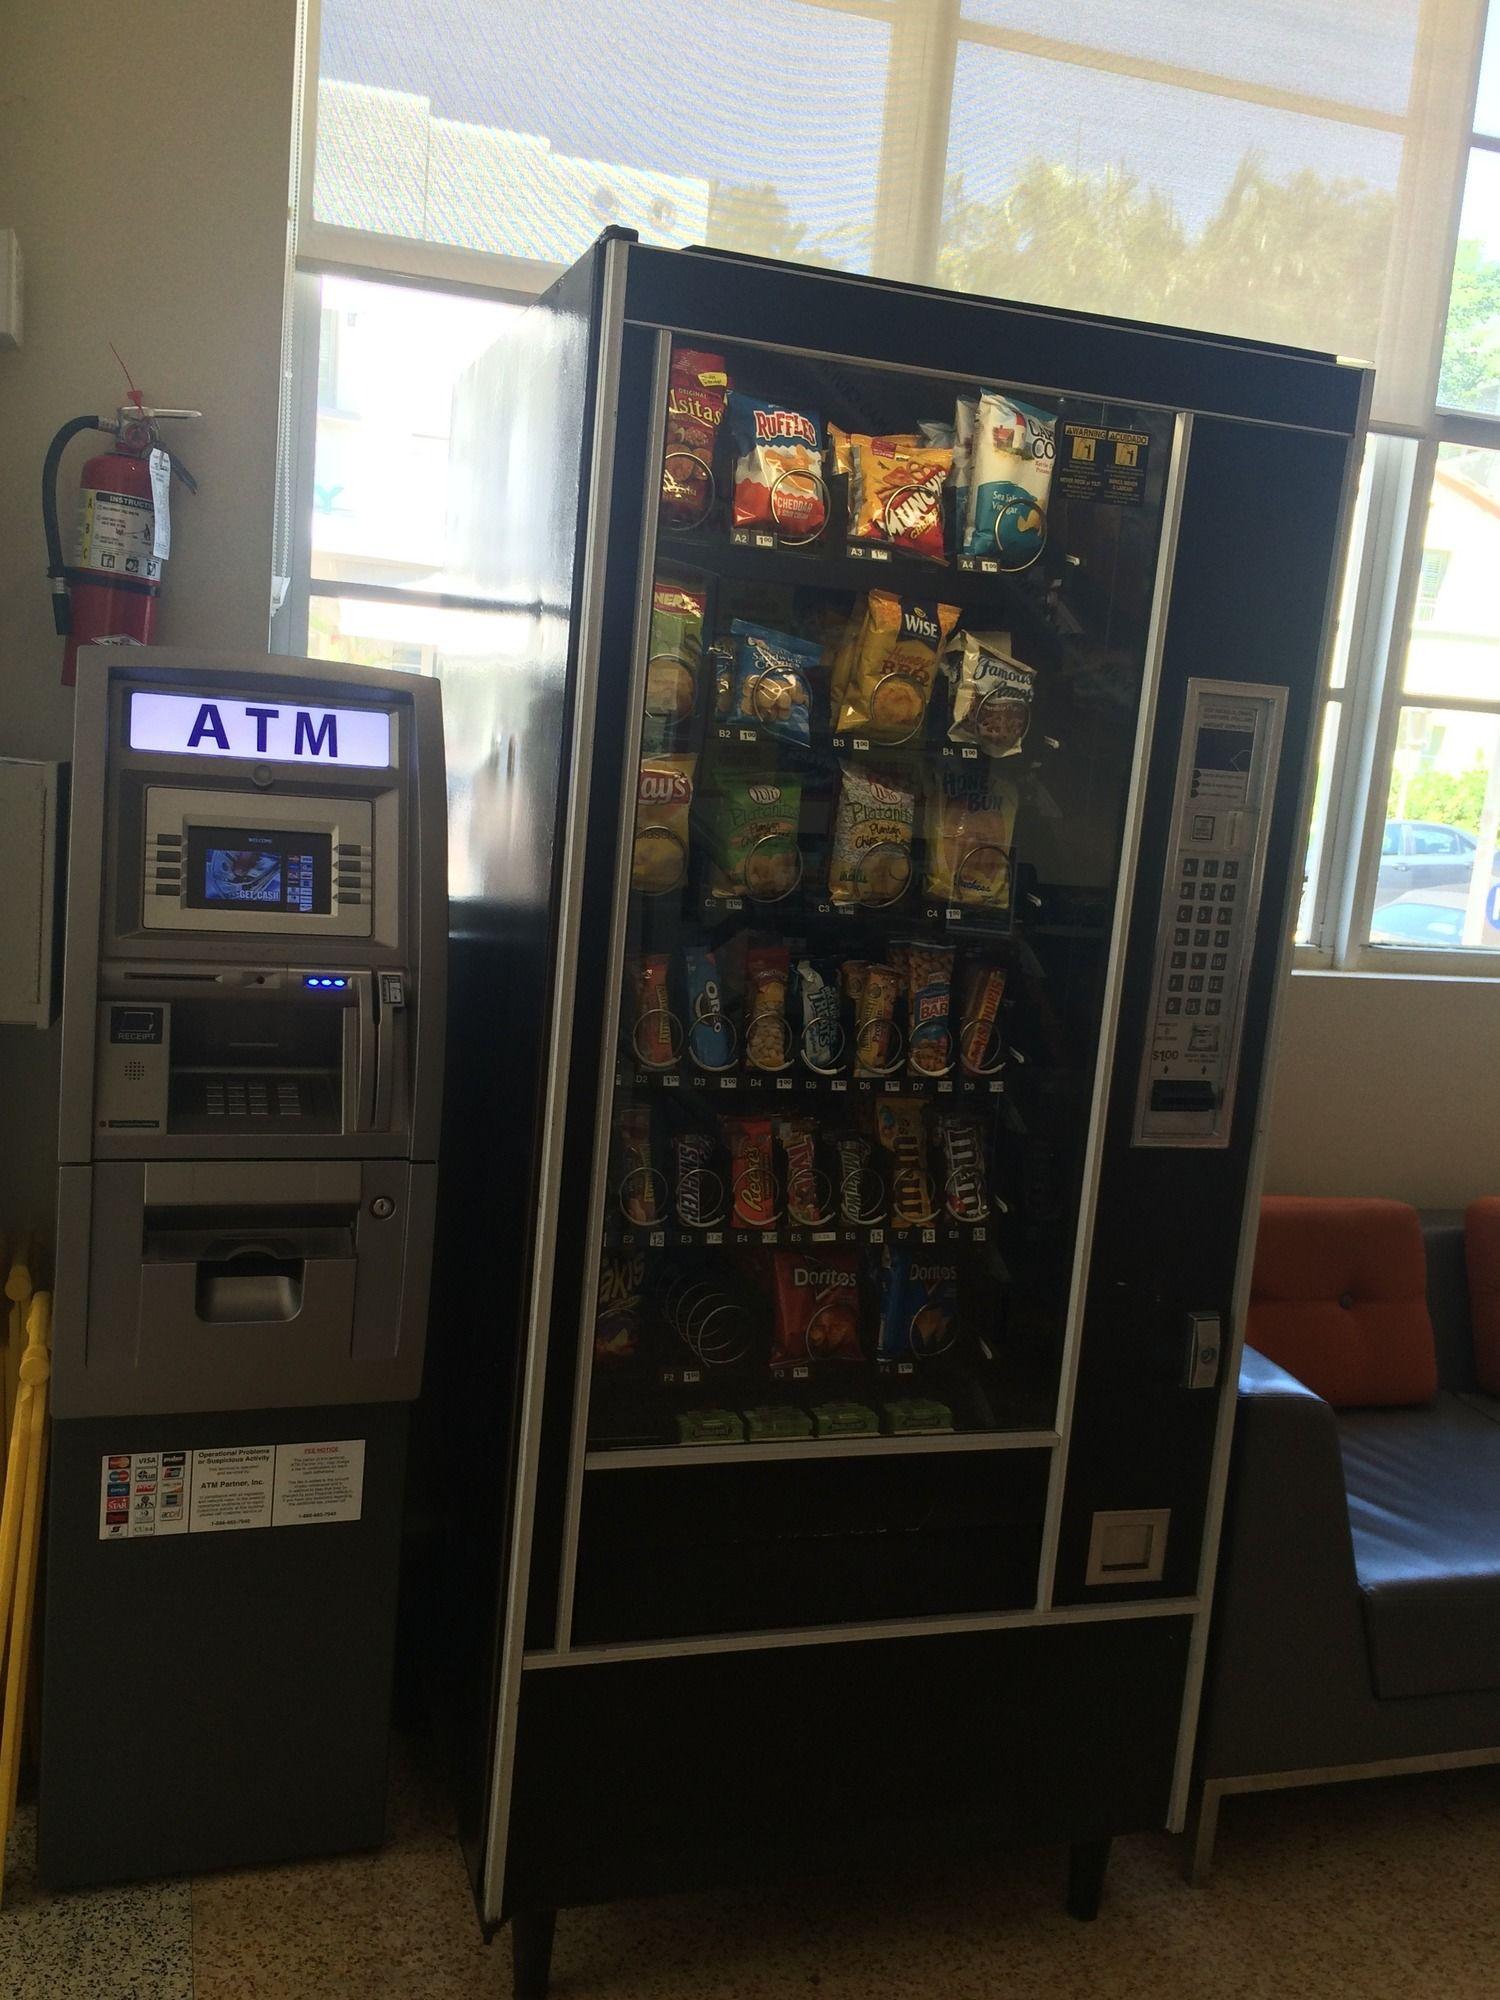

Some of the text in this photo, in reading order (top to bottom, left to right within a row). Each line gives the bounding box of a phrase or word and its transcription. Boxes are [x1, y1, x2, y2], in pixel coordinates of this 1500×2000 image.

[754, 410, 818, 446] RUFFLES
[1073, 427, 1106, 440] WARNING
[993, 490, 1005, 500] Sea
[777, 497, 813, 513] CHEDDAR
[992, 501, 1018, 515] Vingar
[734, 533, 747, 543] A2
[850, 547, 863, 557] A3
[962, 561, 973, 569] A4
[905, 613, 938, 639] WISE
[187, 704, 338, 758] ATM
[718, 730, 731, 738] B2
[832, 739, 845, 747] B3
[943, 747, 954, 756] B4
[239, 889, 279, 900] GET CASH
[818, 905, 830, 913] C3
[926, 910, 938, 918] C4
[920, 1002, 948, 1019] BAR
[118, 1033, 156, 1041] RECEIPT
[805, 1081, 816, 1089] D5
[736, 1234, 748, 1243] E4
[791, 1233, 801, 1241] E5
[845, 1232, 856, 1240] E6
[897, 1231, 909, 1240] E7
[909, 1263, 958, 1281] Doritos
[793, 1267, 857, 1287] Doritos
[198, 1448, 270, 1459] Operational Problems
[139, 1456, 156, 1465] VISA
[207, 1457, 244, 1465] Suspicious
[245, 1454, 270, 1463] Activity
[201, 1481, 218, 1489] ATM
[108, 1501, 128, 1510] STAR
